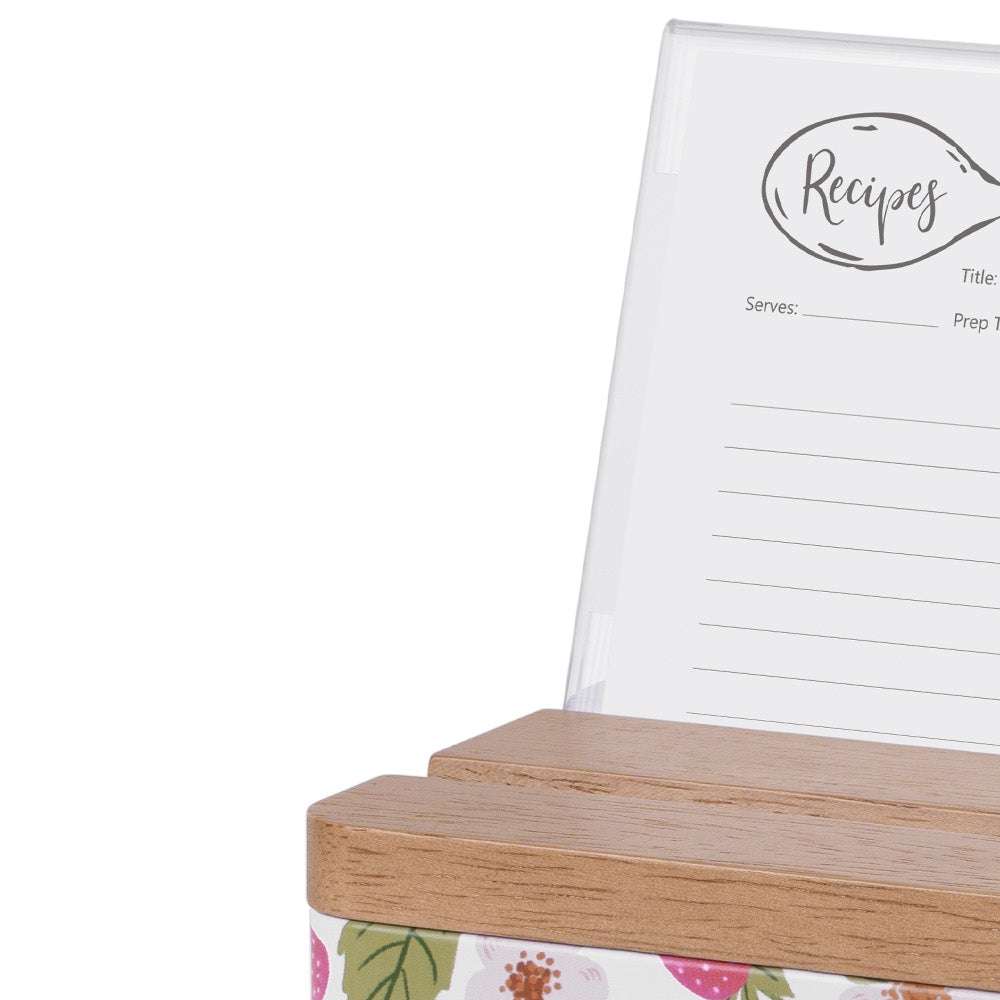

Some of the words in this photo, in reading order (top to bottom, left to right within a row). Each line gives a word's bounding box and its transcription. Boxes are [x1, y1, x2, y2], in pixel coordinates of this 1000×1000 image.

[802, 148, 948, 246] Recipes
[961, 267, 998, 287] Title:
[745, 296, 799, 316] Serves:
[953, 312, 989, 334] Prep
